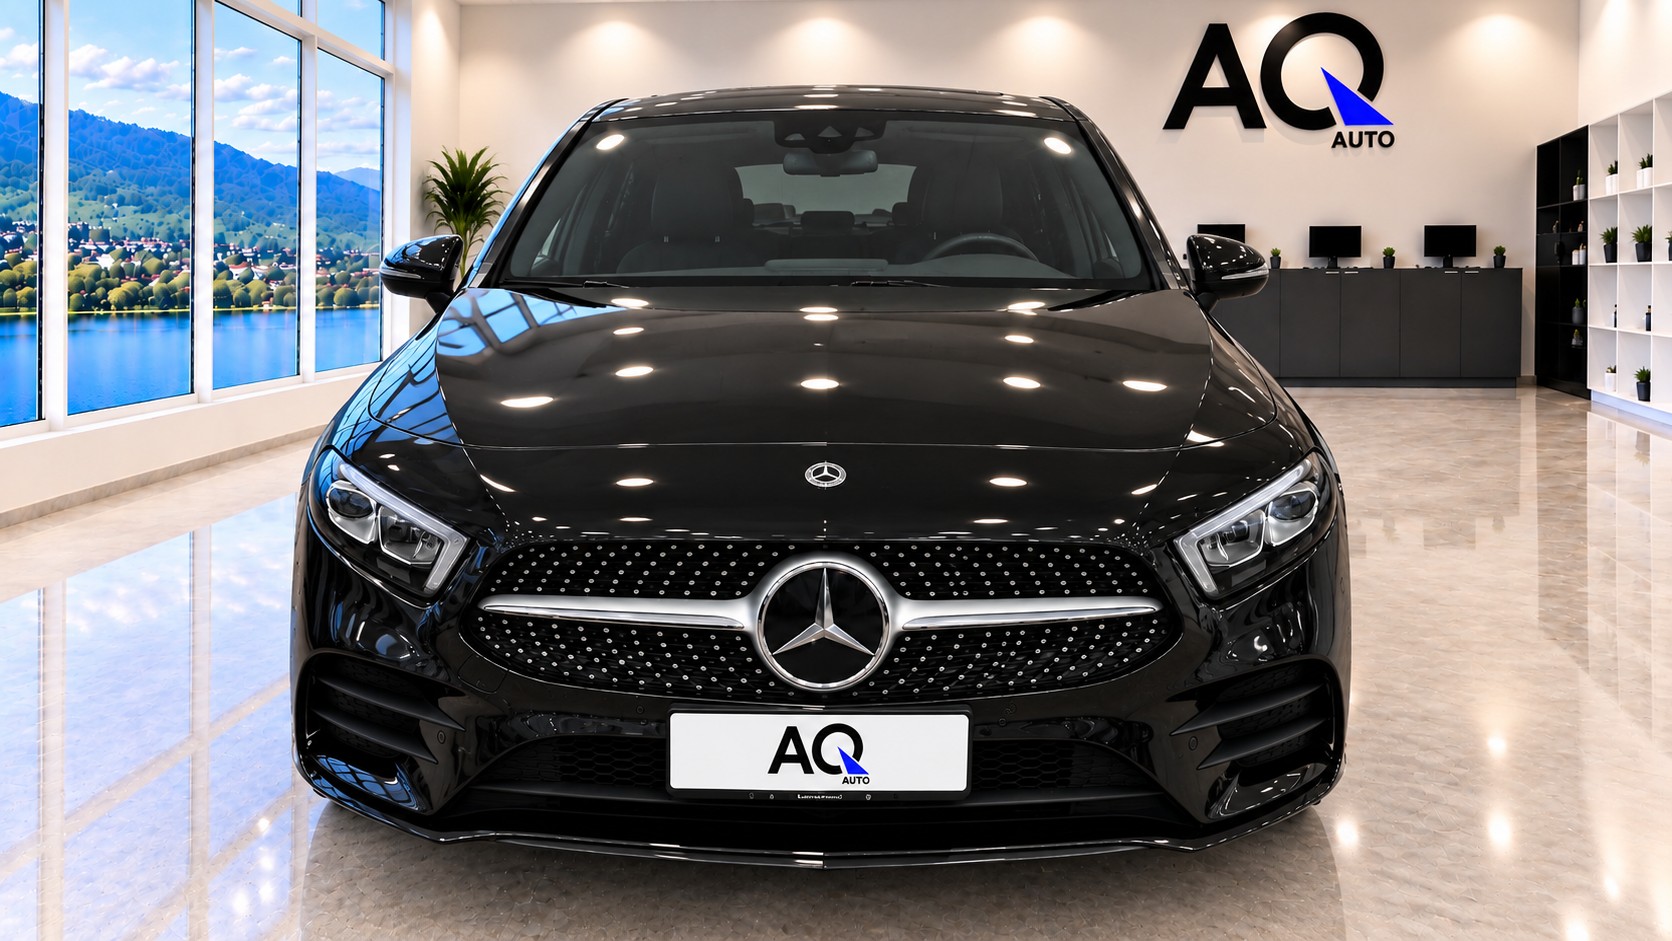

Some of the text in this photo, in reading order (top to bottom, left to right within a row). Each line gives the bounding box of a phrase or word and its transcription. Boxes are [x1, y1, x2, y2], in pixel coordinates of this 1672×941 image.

[1162, 11, 1394, 131] AQ
[1331, 130, 1396, 149] AUTO
[767, 723, 869, 775] AQ
[841, 776, 870, 785] AUTO
